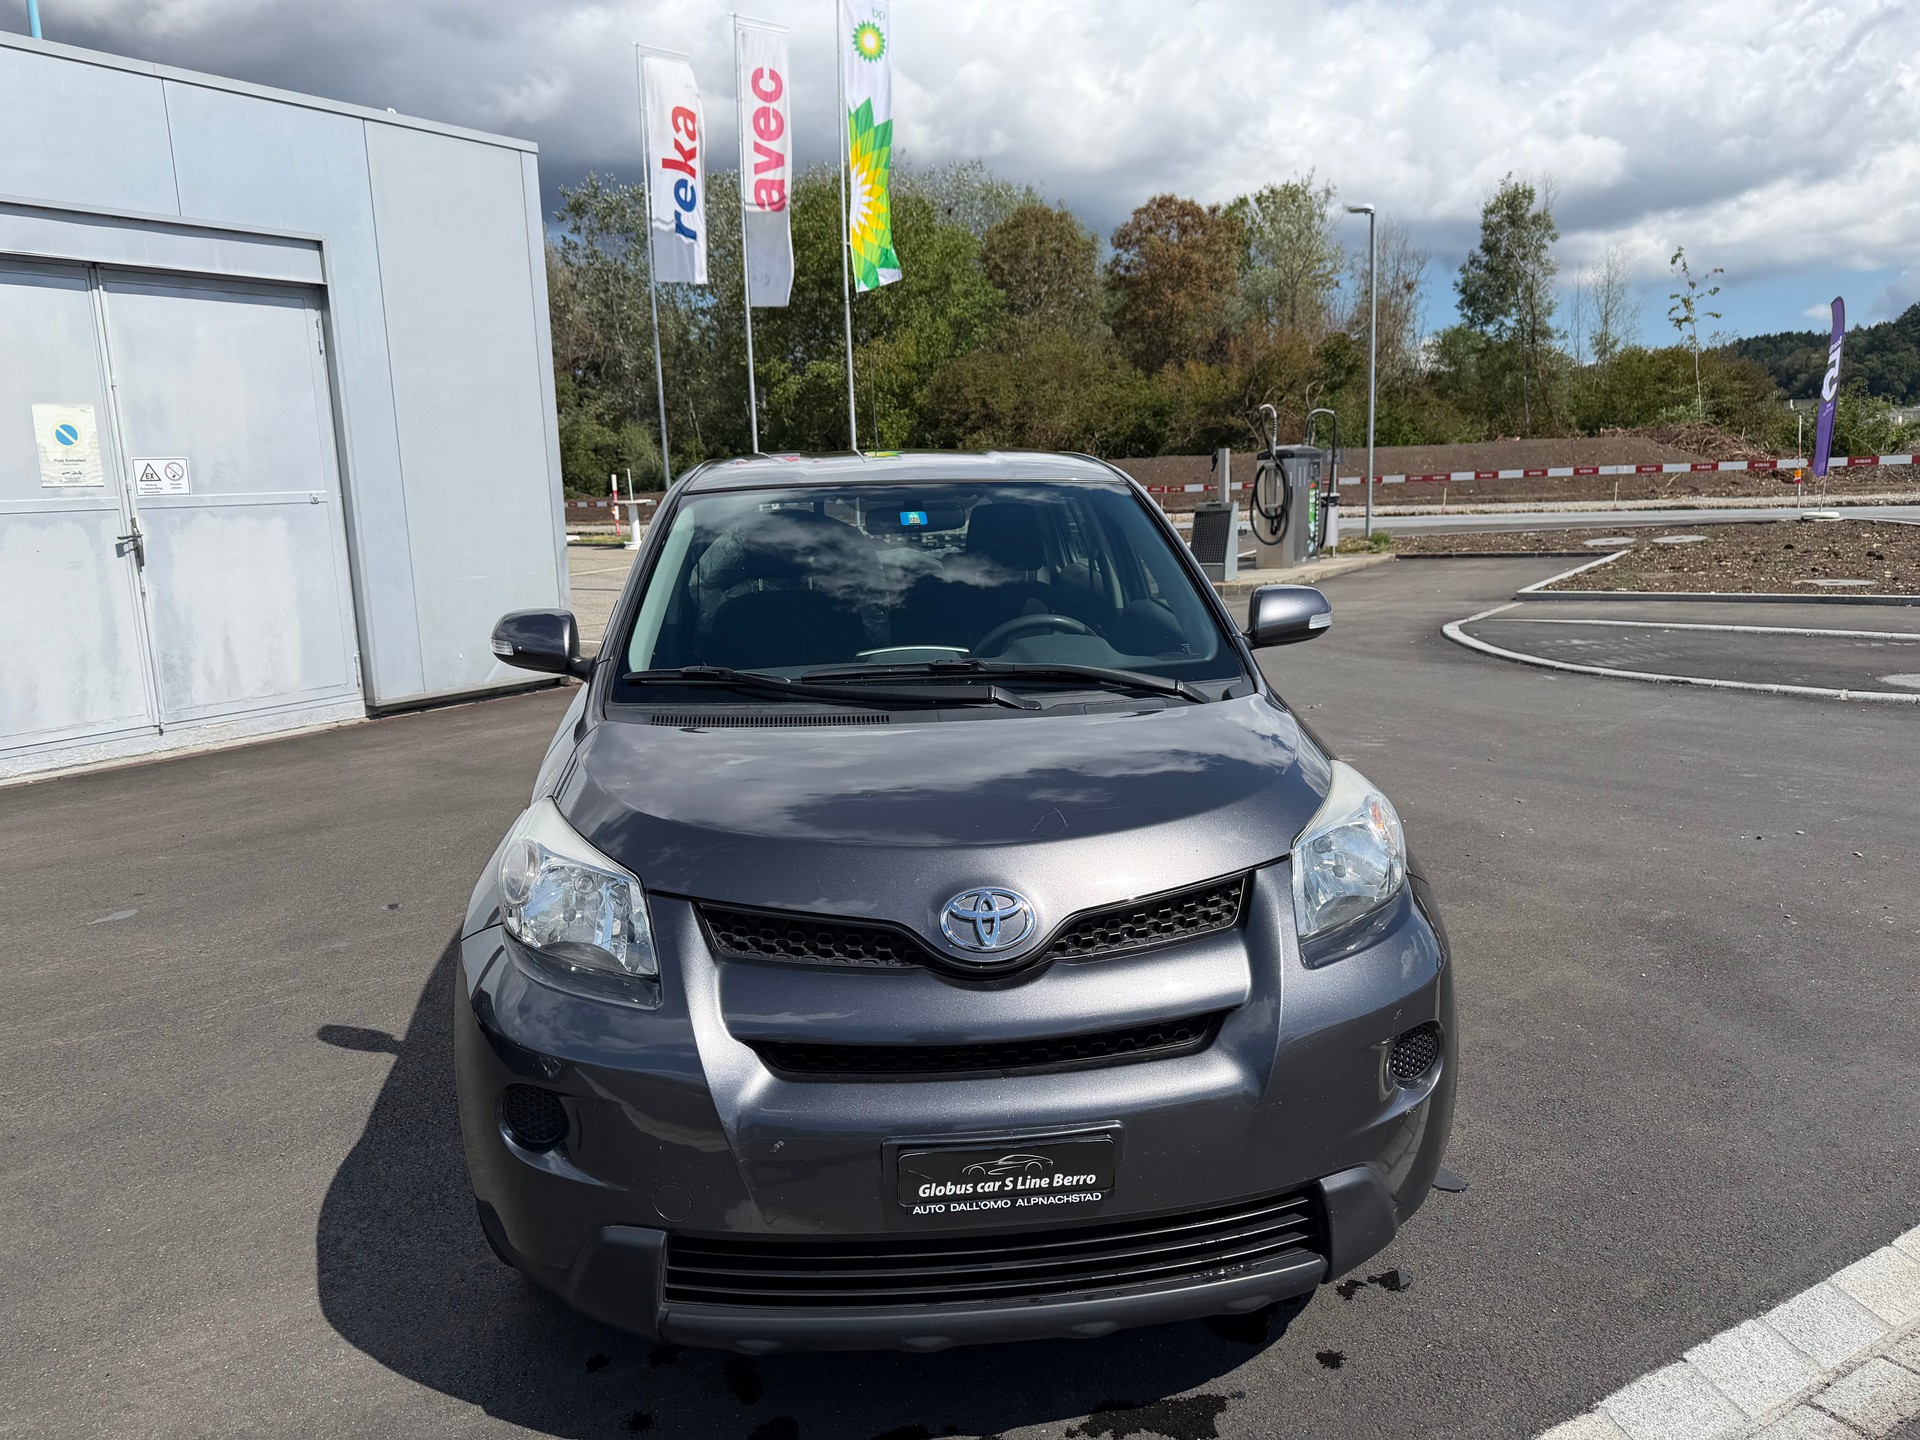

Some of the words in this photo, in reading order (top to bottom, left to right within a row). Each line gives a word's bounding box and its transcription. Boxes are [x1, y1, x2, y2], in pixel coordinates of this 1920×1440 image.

[871, 5, 886, 23] bp
[751, 66, 786, 213] avec
[661, 105, 698, 242] reka
[145, 472, 155, 480] EX
[918, 1181, 973, 1198] Globus
[976, 1178, 1001, 1193] car
[1004, 1176, 1014, 1192] S
[1016, 1174, 1050, 1190] Line
[1052, 1172, 1097, 1188] Berro
[912, 1203, 945, 1215] AUTO
[950, 1198, 1011, 1213] DALL'OMO
[1015, 1191, 1102, 1208] ALPNACHSTAD
